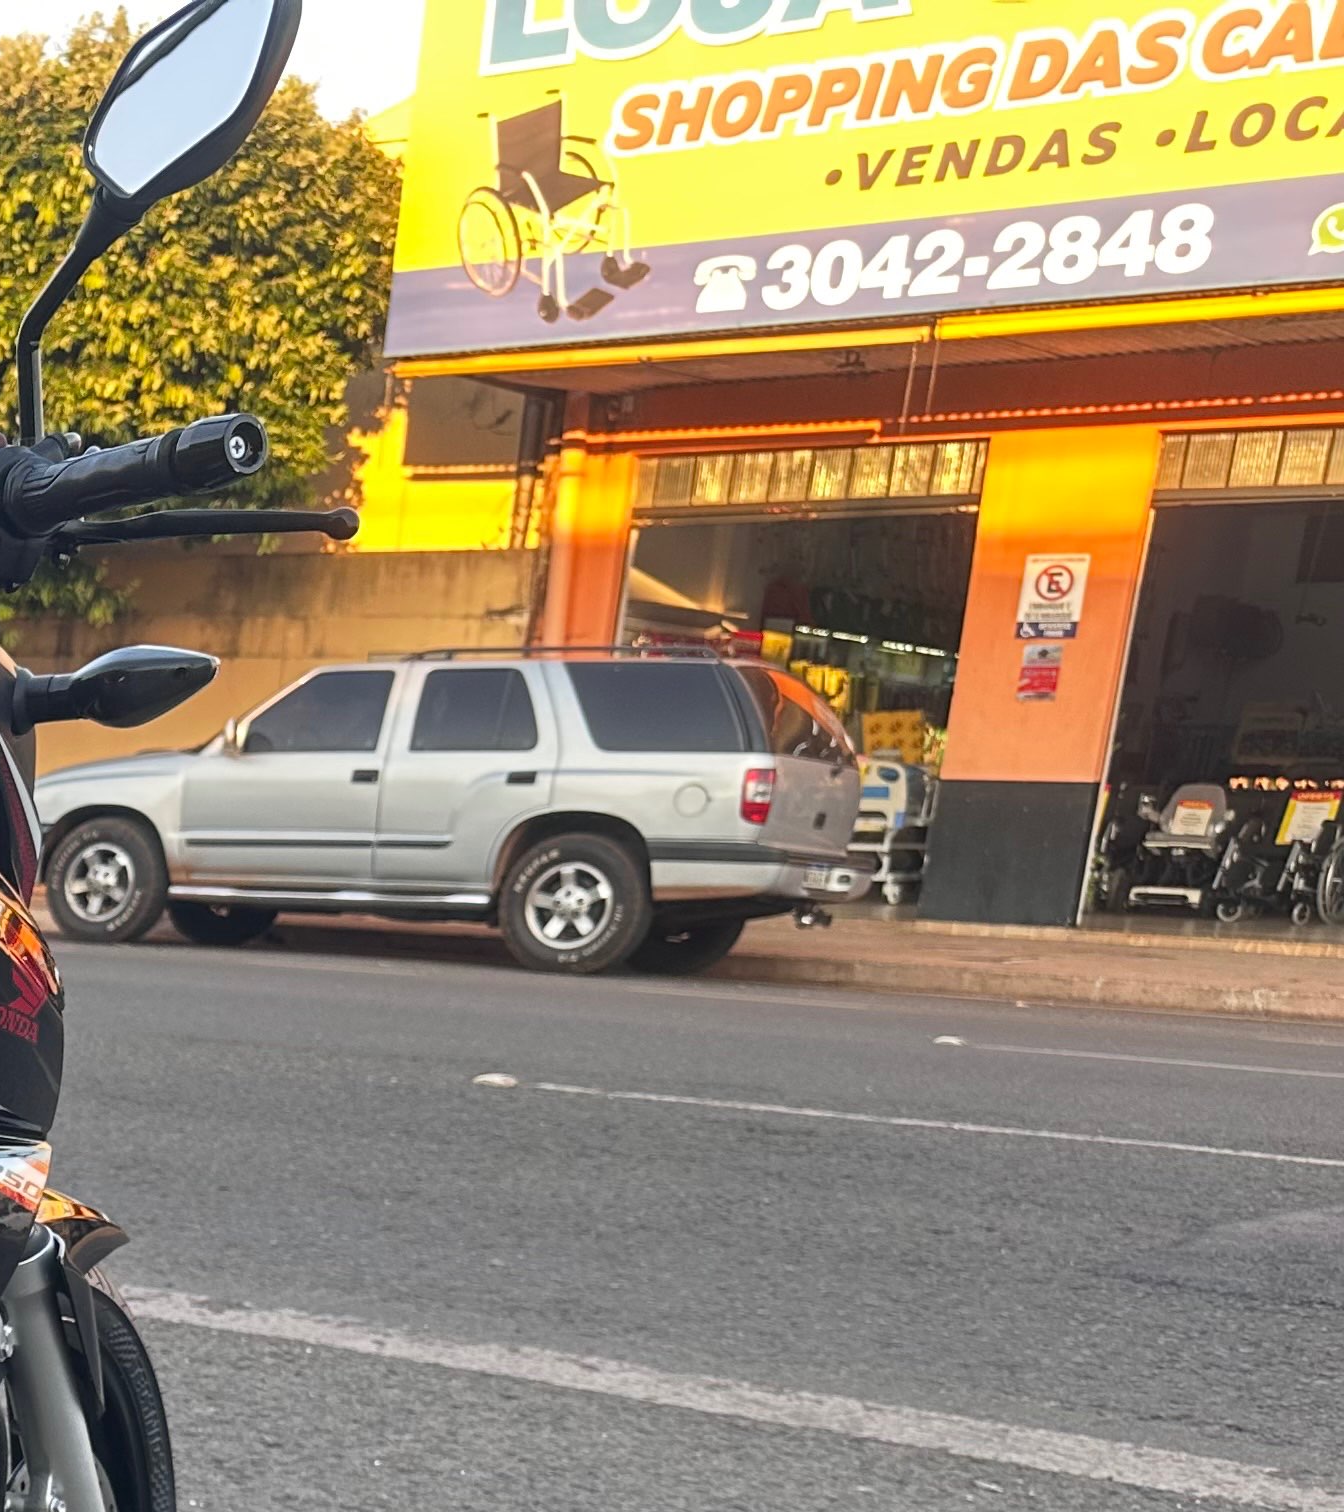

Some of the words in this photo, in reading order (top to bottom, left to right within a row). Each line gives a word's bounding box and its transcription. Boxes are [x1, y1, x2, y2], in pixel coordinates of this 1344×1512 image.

[614, 46, 998, 151] SHOPPING
[1008, 19, 1187, 101] DAS
[856, 121, 1123, 191] VENDAS
[760, 202, 1215, 300] 3042-2848
